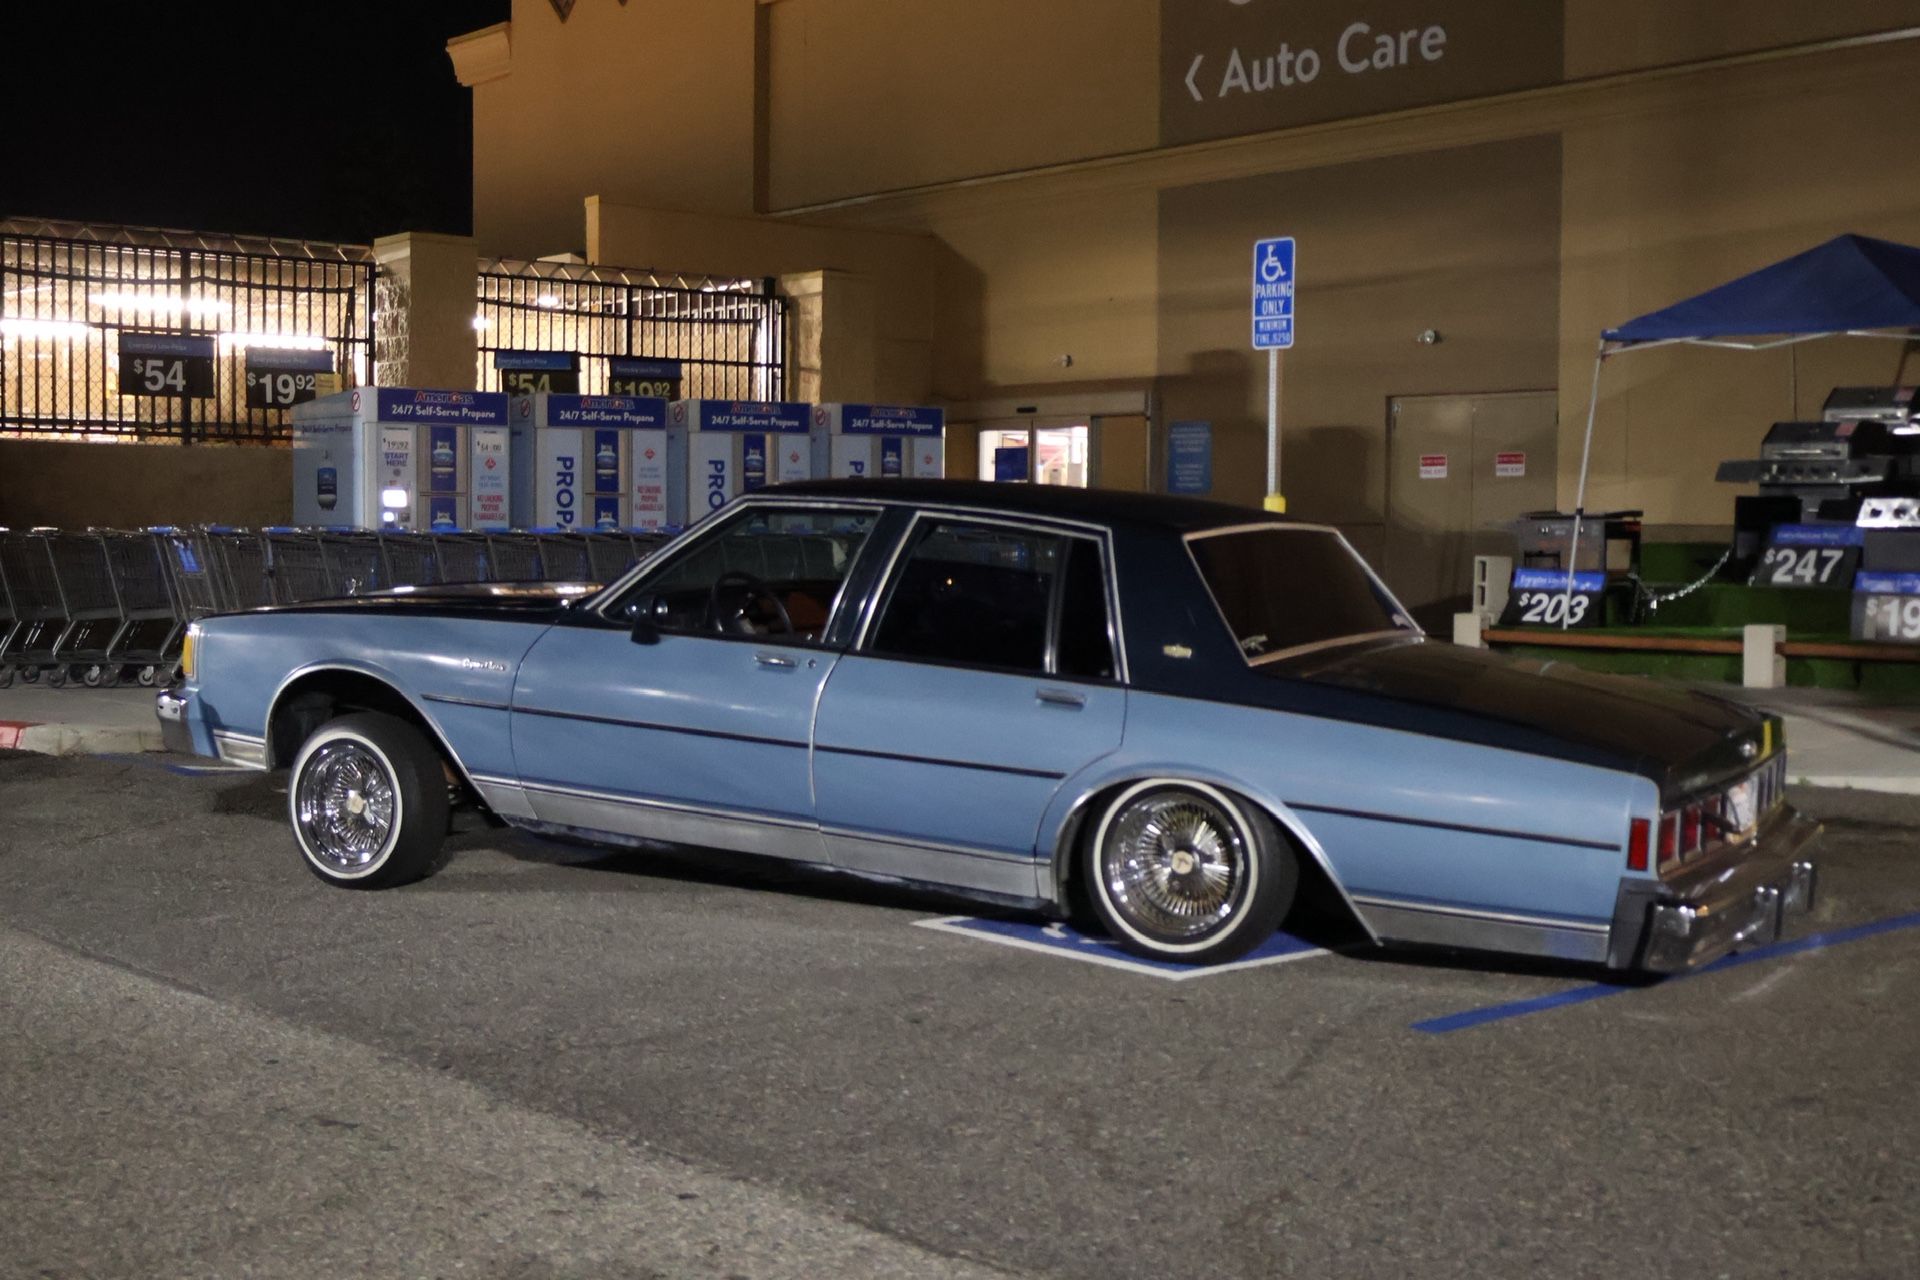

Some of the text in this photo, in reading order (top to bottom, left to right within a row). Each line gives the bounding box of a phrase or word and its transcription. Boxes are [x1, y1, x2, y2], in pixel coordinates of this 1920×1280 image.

[1218, 22, 1447, 97] Auto Care
[1256, 282, 1292, 299] PARKING
[1262, 300, 1285, 315] ONLY
[133, 358, 186, 392] $54
[391, 405, 496, 420] 24/7 Self-Serve Propane
[560, 410, 655, 424] 24/7 Self-Serve Propane
[712, 416, 729, 425] 24/7
[771, 417, 799, 428] Propane
[1764, 548, 1843, 583] $247
[1518, 592, 1589, 625] $203
